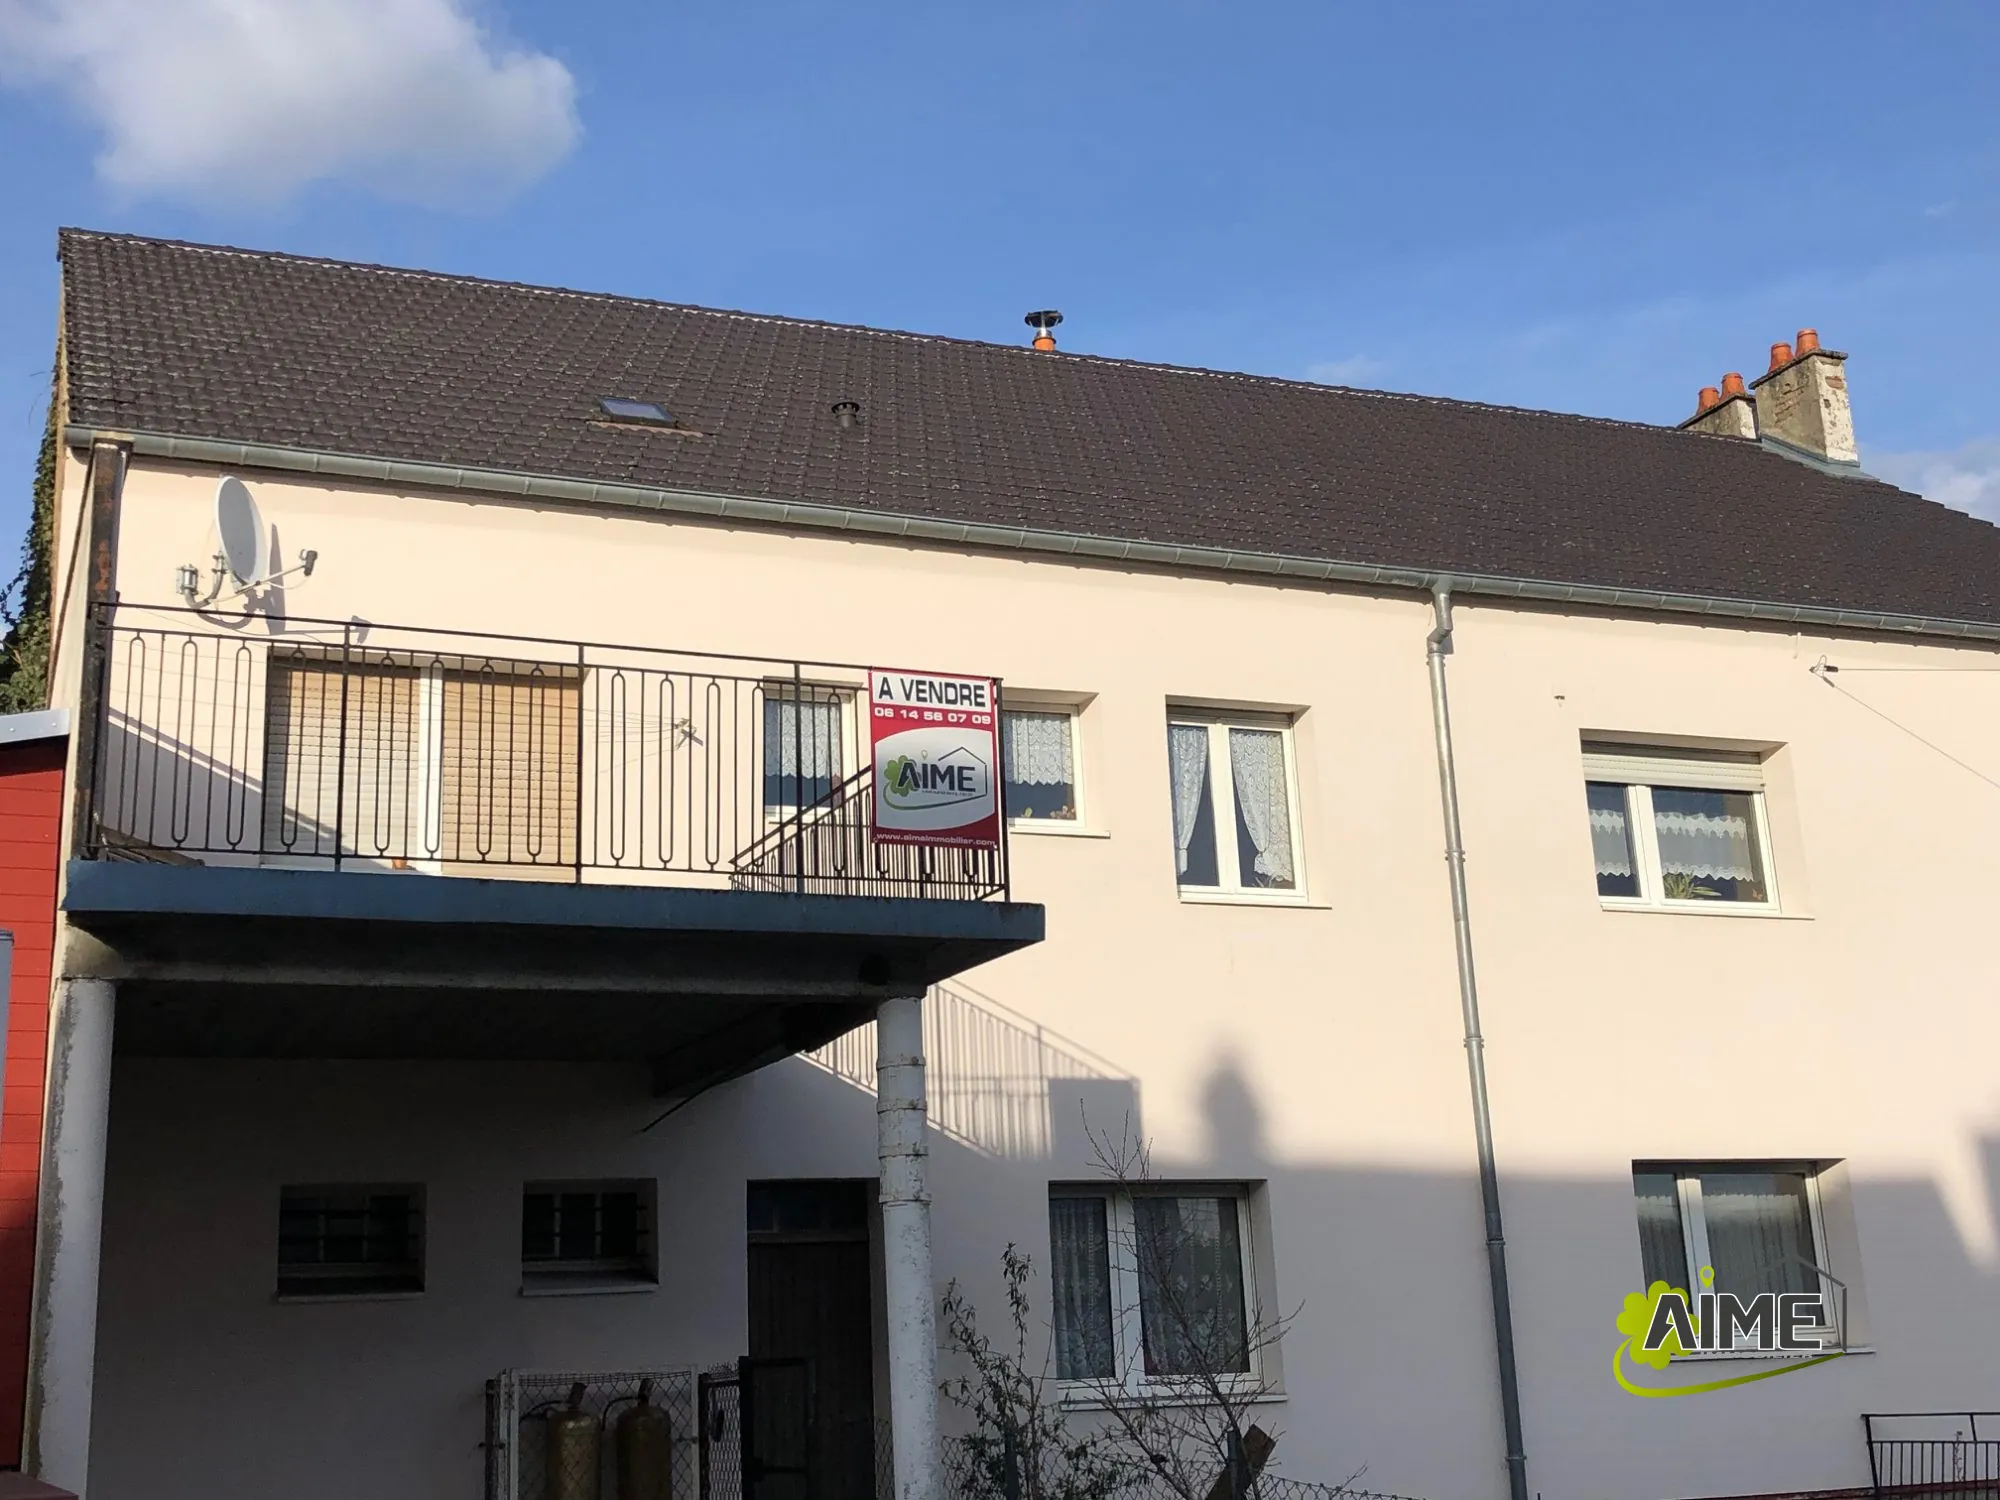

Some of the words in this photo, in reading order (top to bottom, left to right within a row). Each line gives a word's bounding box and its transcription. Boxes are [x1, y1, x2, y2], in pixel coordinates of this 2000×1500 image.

[878, 676, 894, 701] A
[899, 678, 986, 708] VENDRE
[874, 707, 894, 718] 06
[900, 709, 919, 720] 14
[947, 713, 967, 723] 07
[972, 714, 991, 725] 09
[897, 762, 976, 793] AIME
